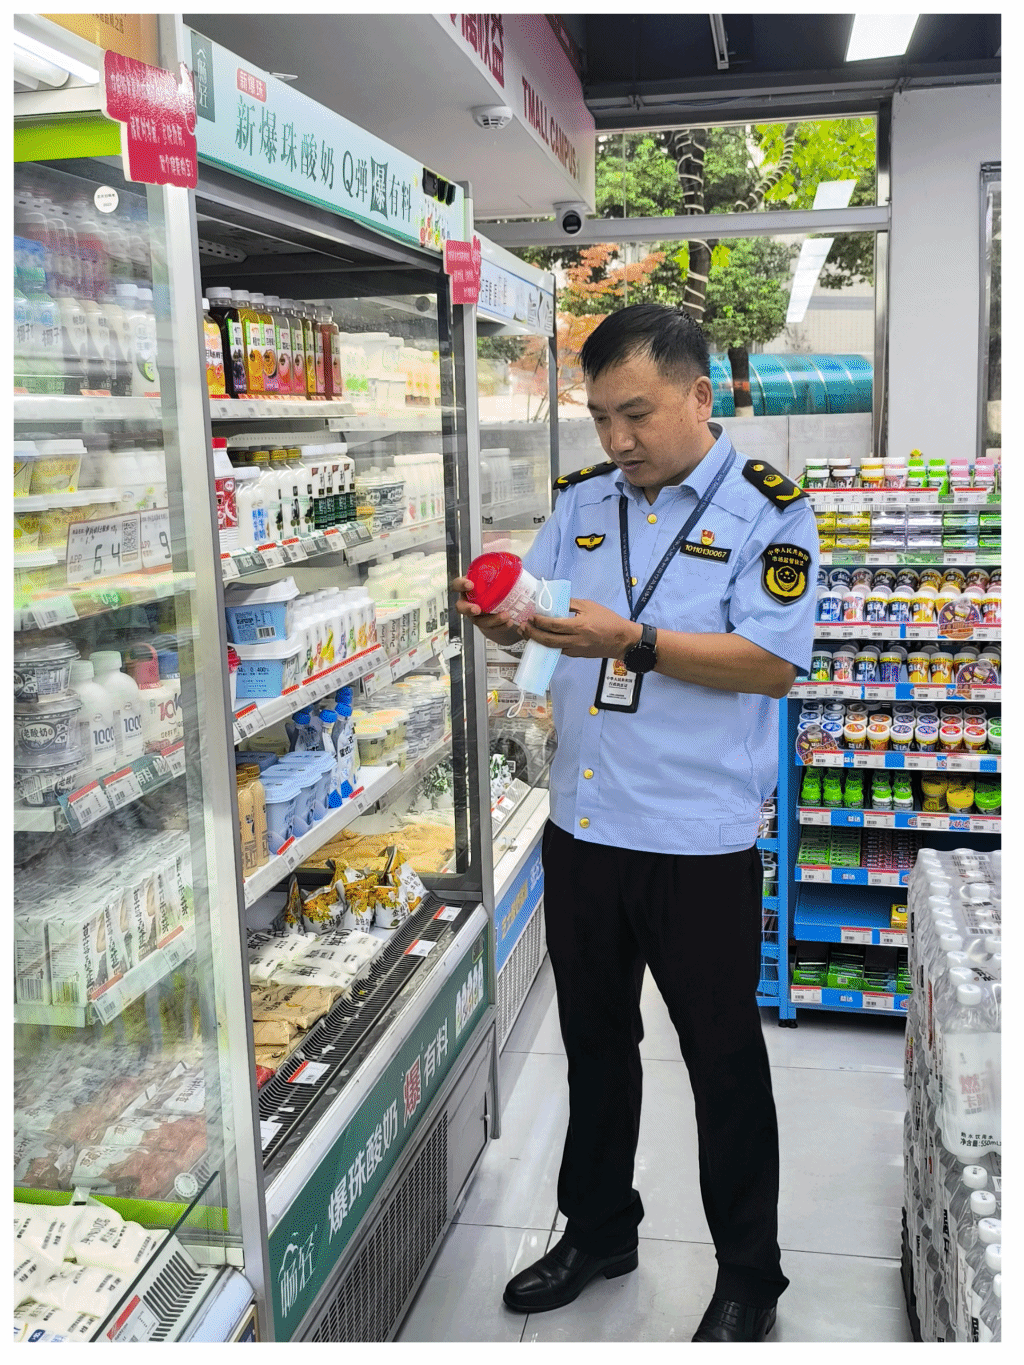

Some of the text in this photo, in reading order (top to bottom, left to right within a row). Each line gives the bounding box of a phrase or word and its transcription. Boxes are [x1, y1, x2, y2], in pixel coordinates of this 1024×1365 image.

[234, 95, 335, 190] 新爆珠酸奶
[522, 75, 577, 180] TMALL CAMPUS
[684, 543, 728, 559] 10110130067
[767, 546, 809, 562] 中华人民共和国
[327, 1098, 398, 1246] 爆珠酸奶
